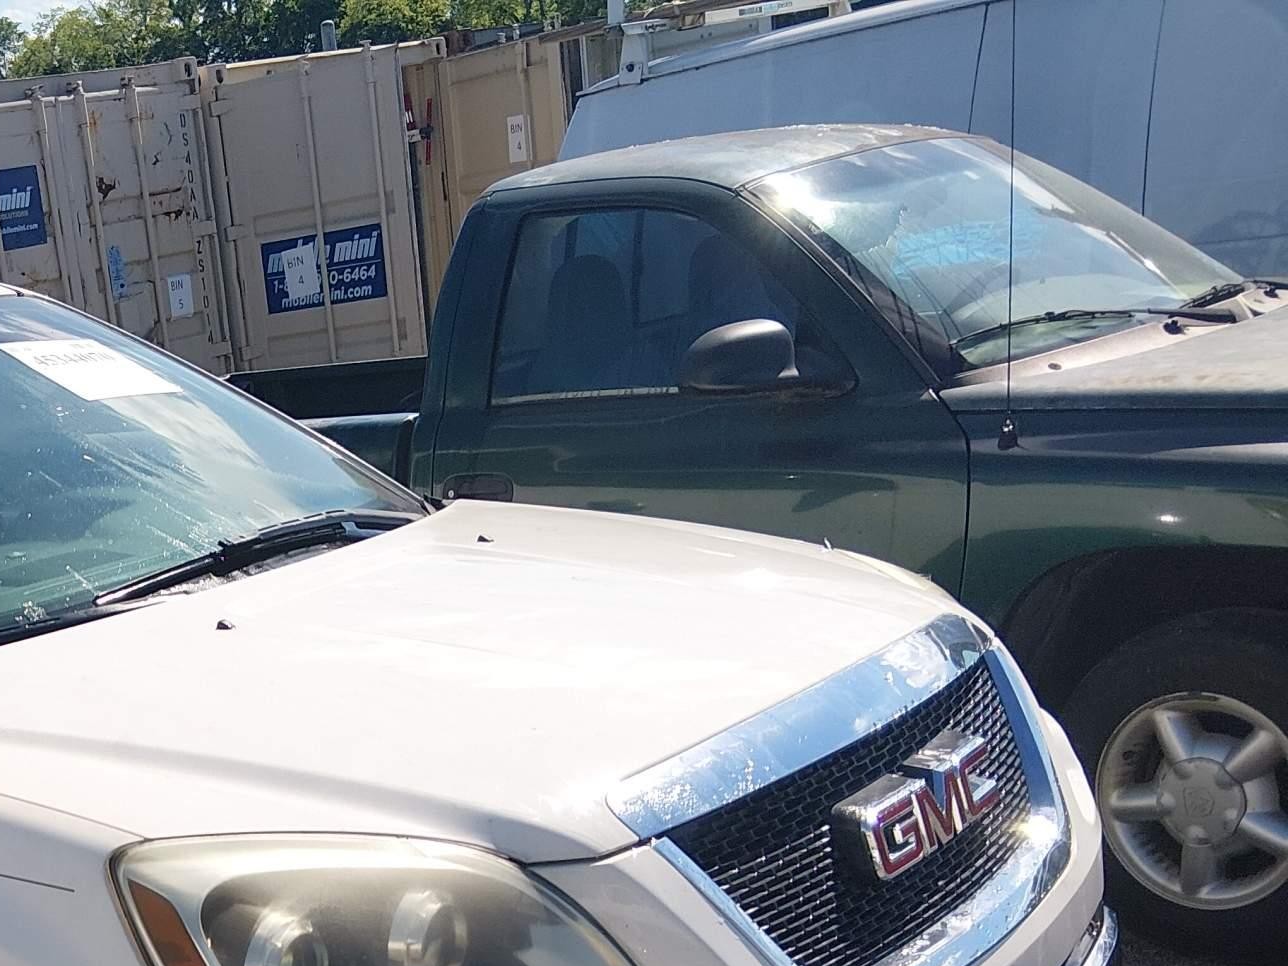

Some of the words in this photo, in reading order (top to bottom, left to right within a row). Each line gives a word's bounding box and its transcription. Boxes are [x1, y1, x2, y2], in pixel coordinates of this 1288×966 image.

[510, 123, 523, 134] BIN
[333, 231, 378, 263] mini
[171, 280, 184, 292] BIN
[178, 299, 184, 310] 5
[868, 743, 1001, 877] GMC
